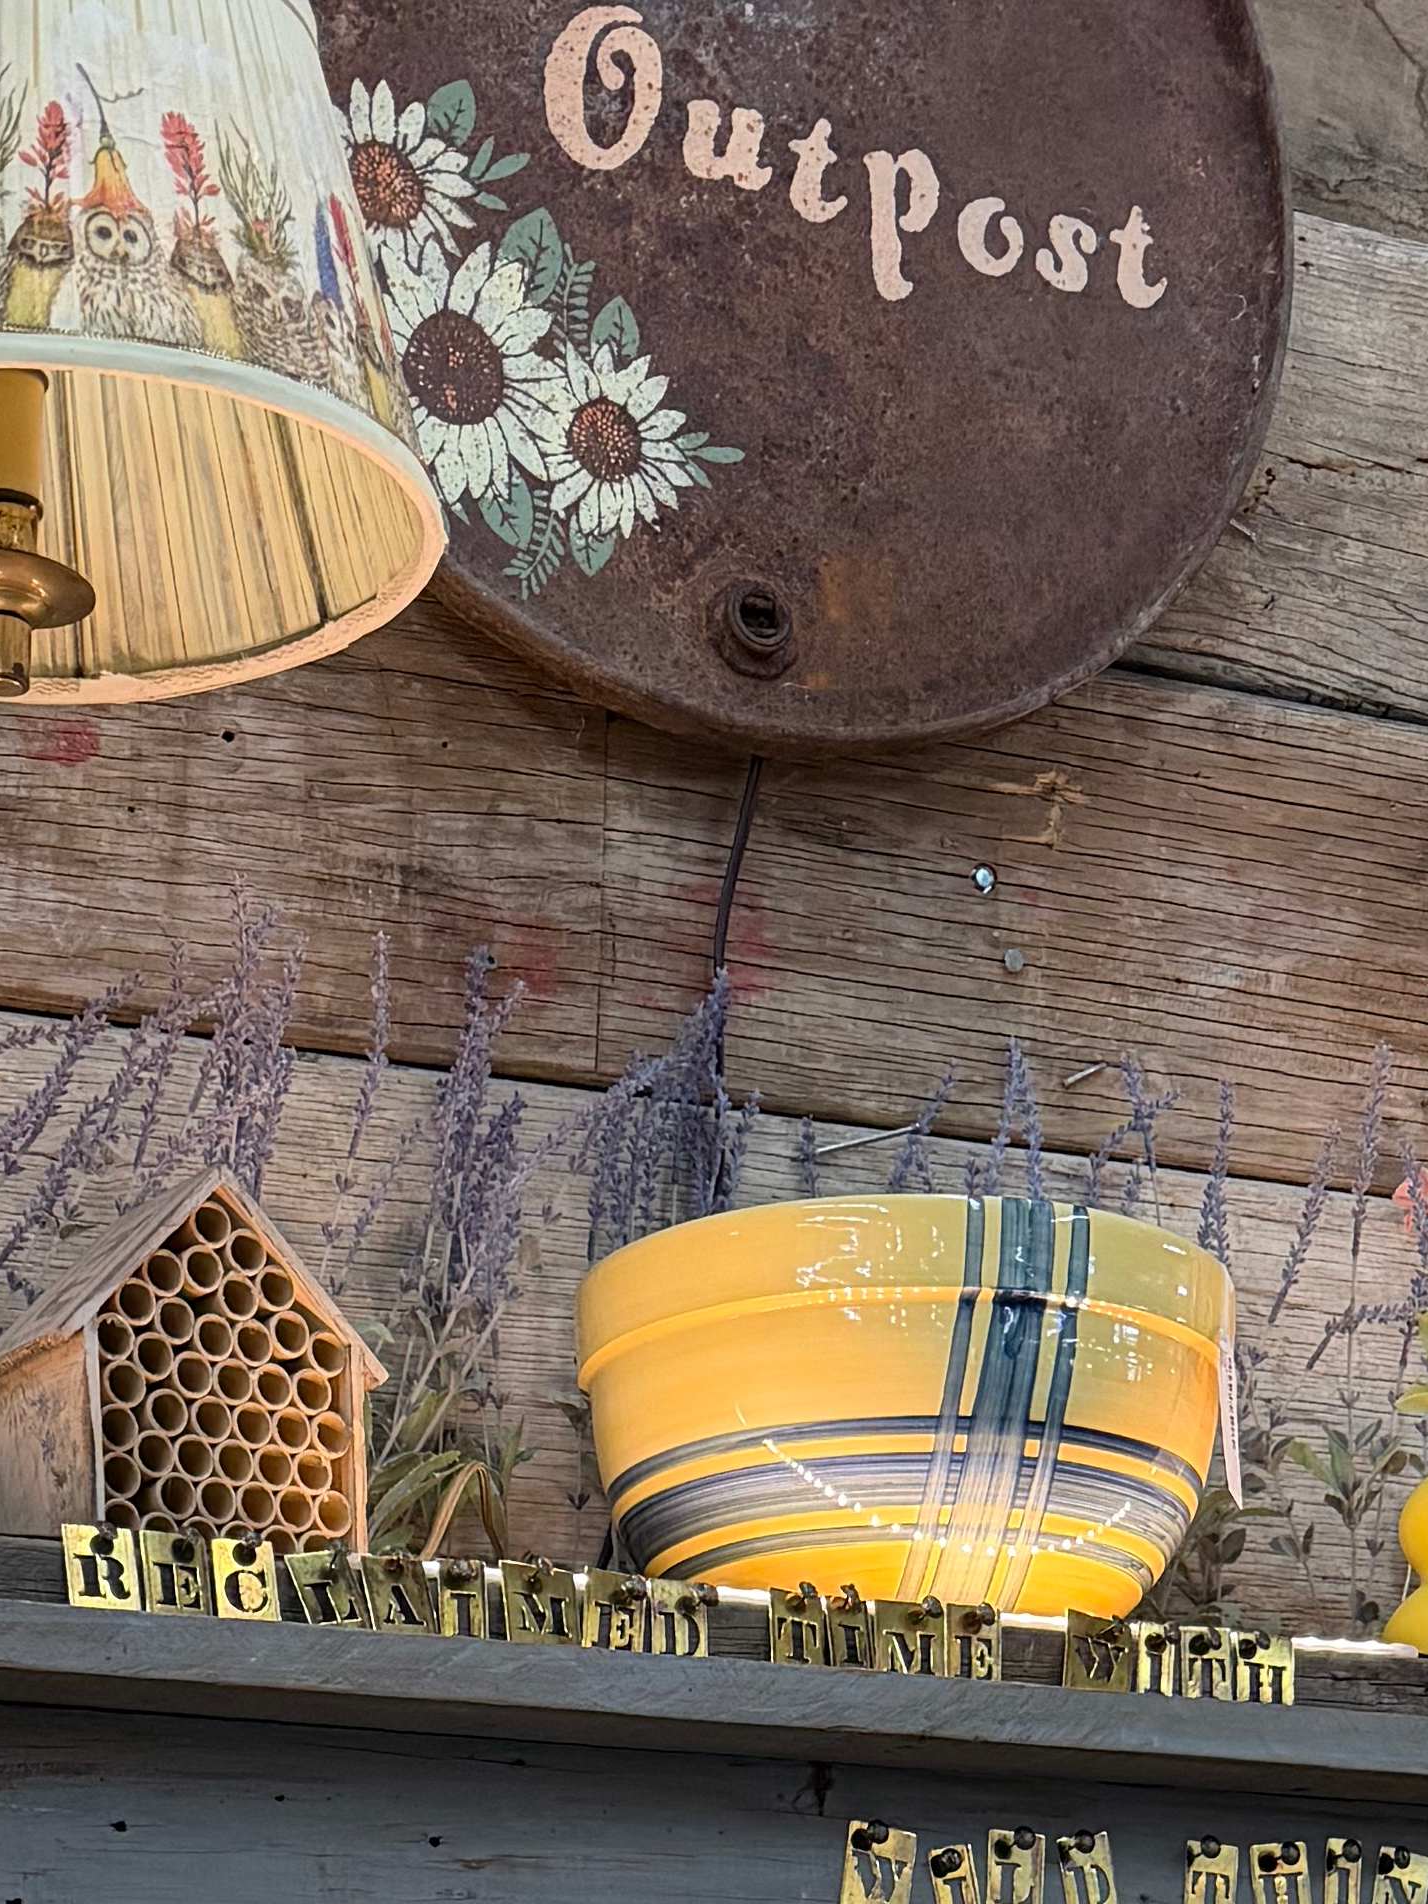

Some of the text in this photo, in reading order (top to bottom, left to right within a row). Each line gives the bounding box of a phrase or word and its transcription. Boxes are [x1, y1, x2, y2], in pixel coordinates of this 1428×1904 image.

[544, 5, 1168, 309] Outpost
[79, 1552, 702, 1657] RECLAIMED
[776, 1615, 994, 1681] TIME
